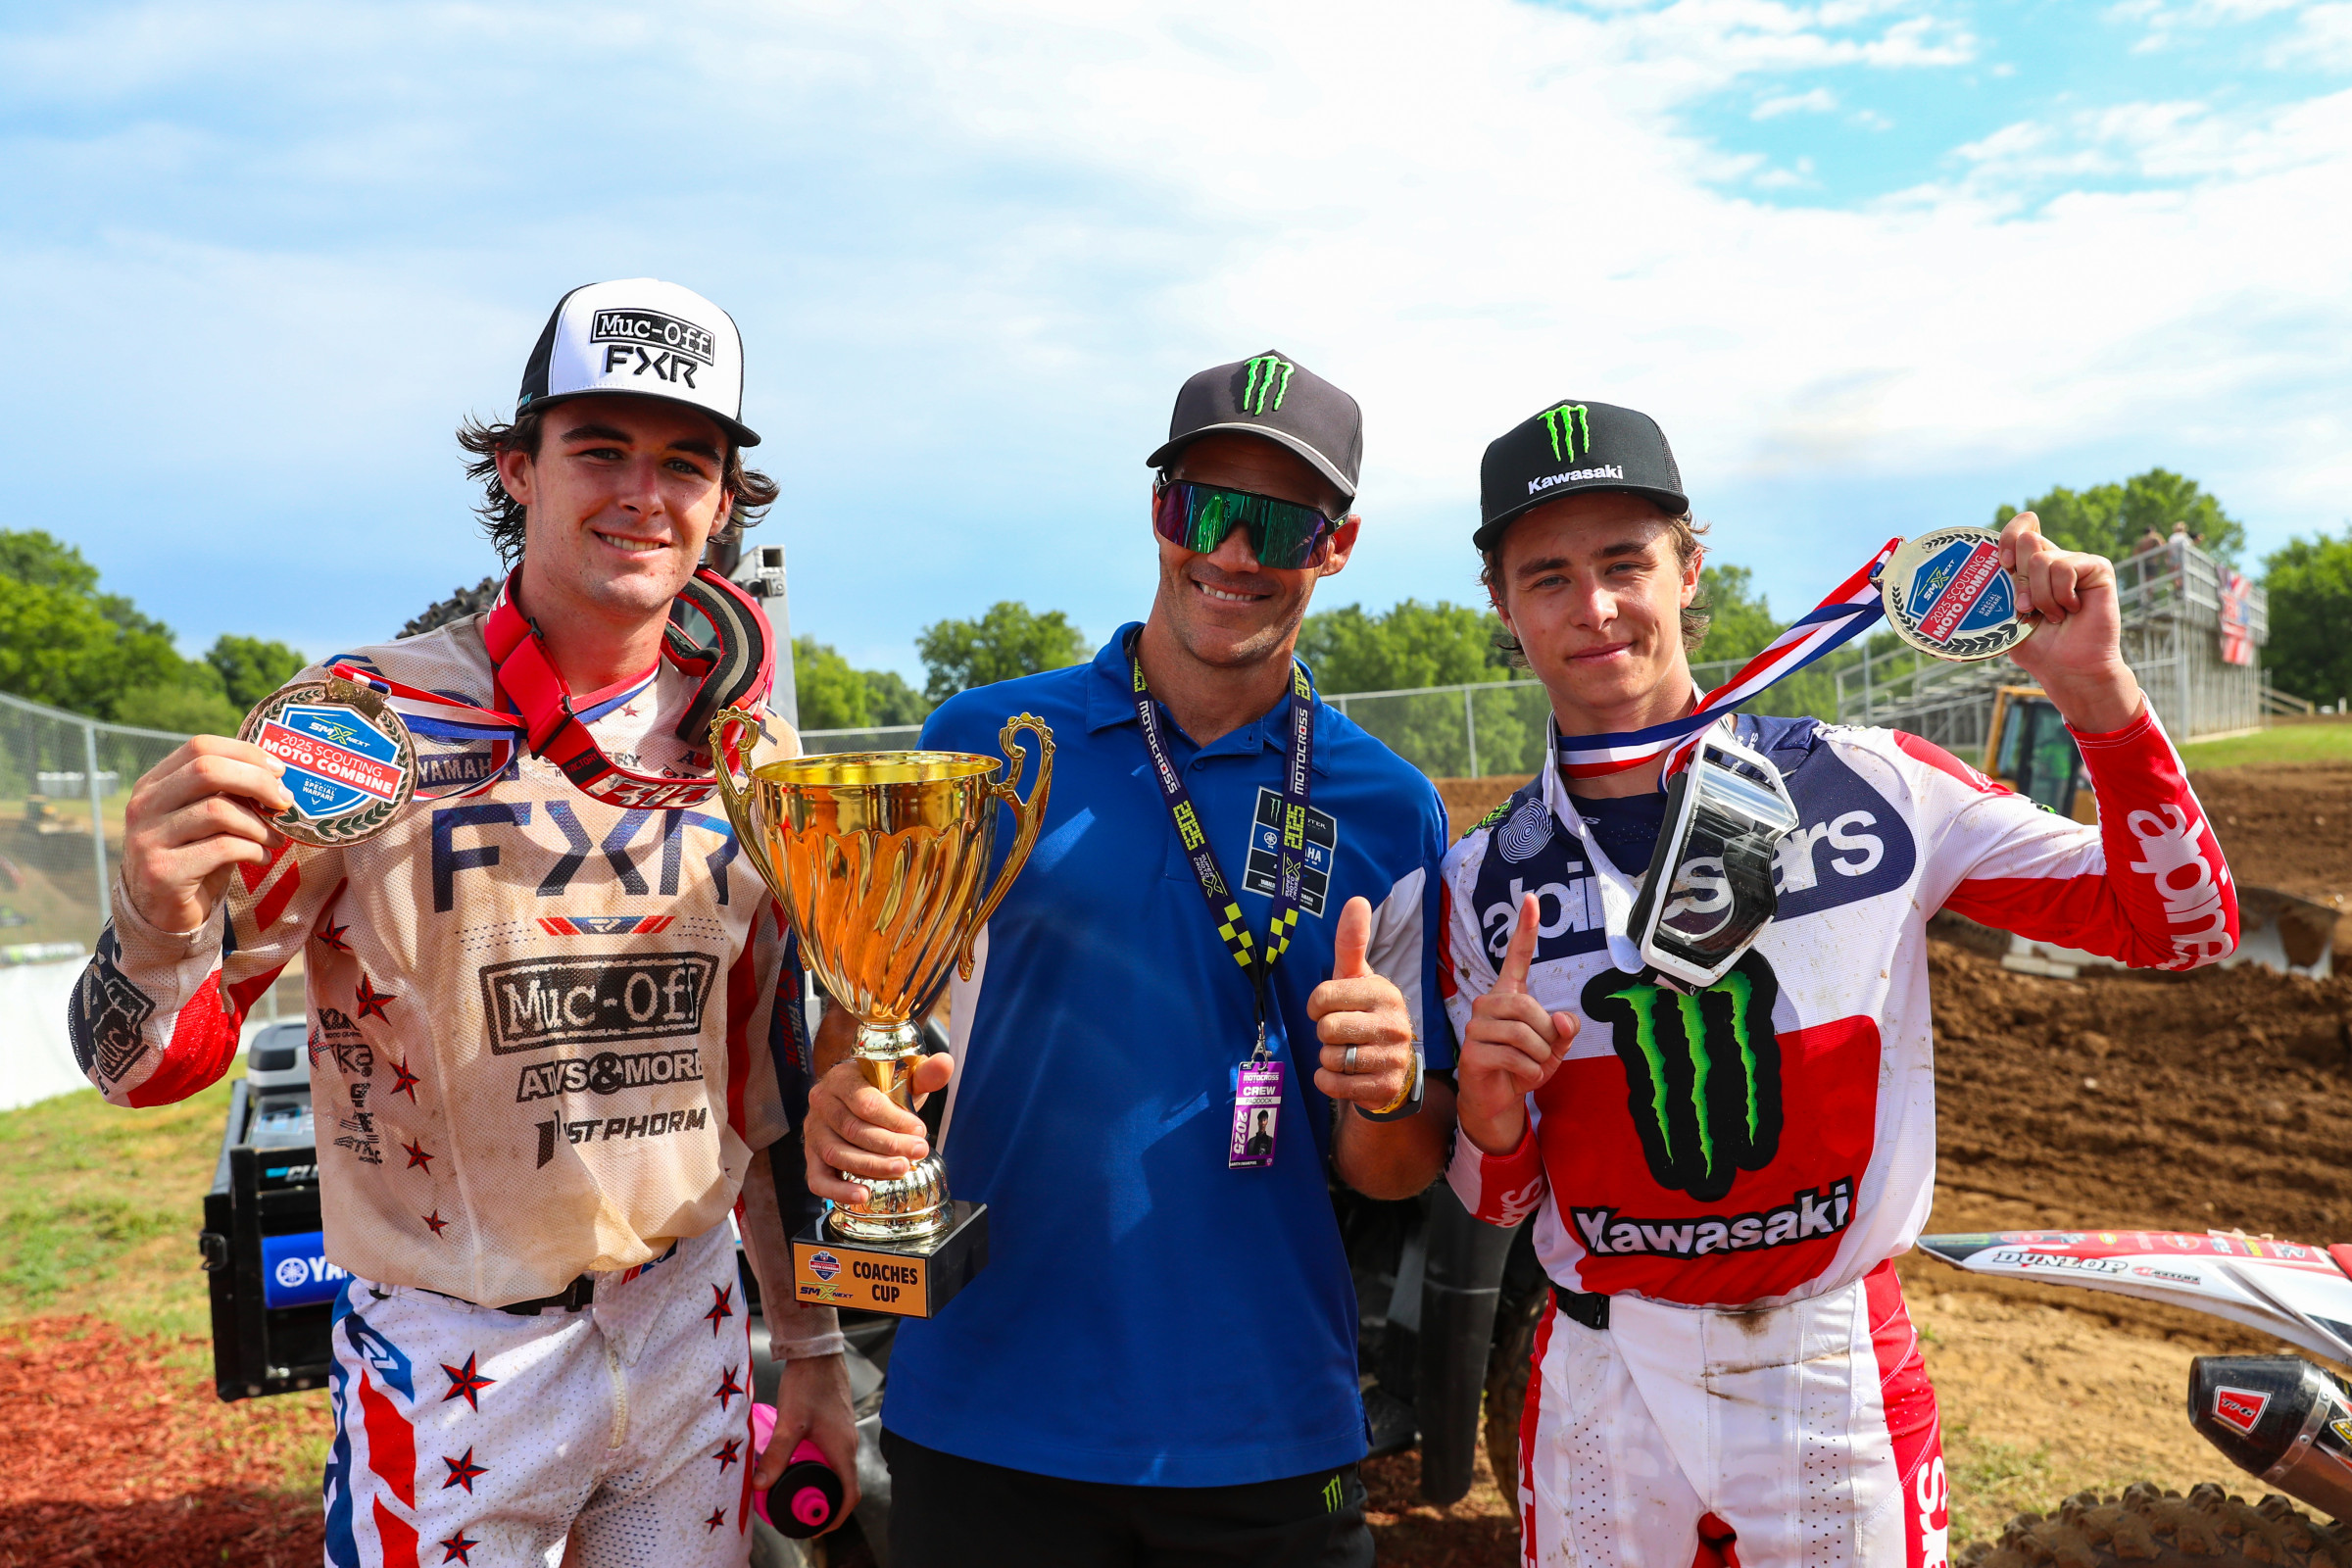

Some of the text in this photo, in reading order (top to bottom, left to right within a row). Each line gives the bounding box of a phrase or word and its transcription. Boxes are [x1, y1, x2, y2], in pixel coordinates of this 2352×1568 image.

[598, 314, 711, 359] Muc-Off
[605, 344, 698, 389] FXR
[1527, 464, 1624, 495] Kawasaki
[1930, 600, 1951, 624] 2025
[1946, 554, 1986, 602] SCOUTING
[1941, 559, 1955, 576] NEXT
[1932, 603, 1964, 638] MOTO
[1959, 549, 2000, 603] COMBINE
[280, 733, 383, 778] 2025 SCOUTING
[346, 736, 371, 748] NEXT
[565, 752, 600, 774] FACTORY
[1139, 700, 1178, 794] MOTOCROSS
[1294, 708, 1308, 796] MOTOCROSS
[262, 738, 394, 795] MOTO COMBINE
[304, 780, 335, 796] SPECIAL
[302, 787, 334, 802] WARFARE
[1172, 800, 1205, 851] 2025
[1284, 803, 1306, 851] 2025
[431, 800, 741, 914] FXR
[787, 1004, 808, 1075] FACTORY
[1243, 1086, 1276, 1097] CREW
[1233, 1109, 1249, 1154] 2025
[1572, 1179, 1851, 1257] Kawasaki
[852, 1260, 918, 1286] COACHES
[1992, 1250, 2129, 1274] DUNLOP
[871, 1284, 901, 1303] CUP
